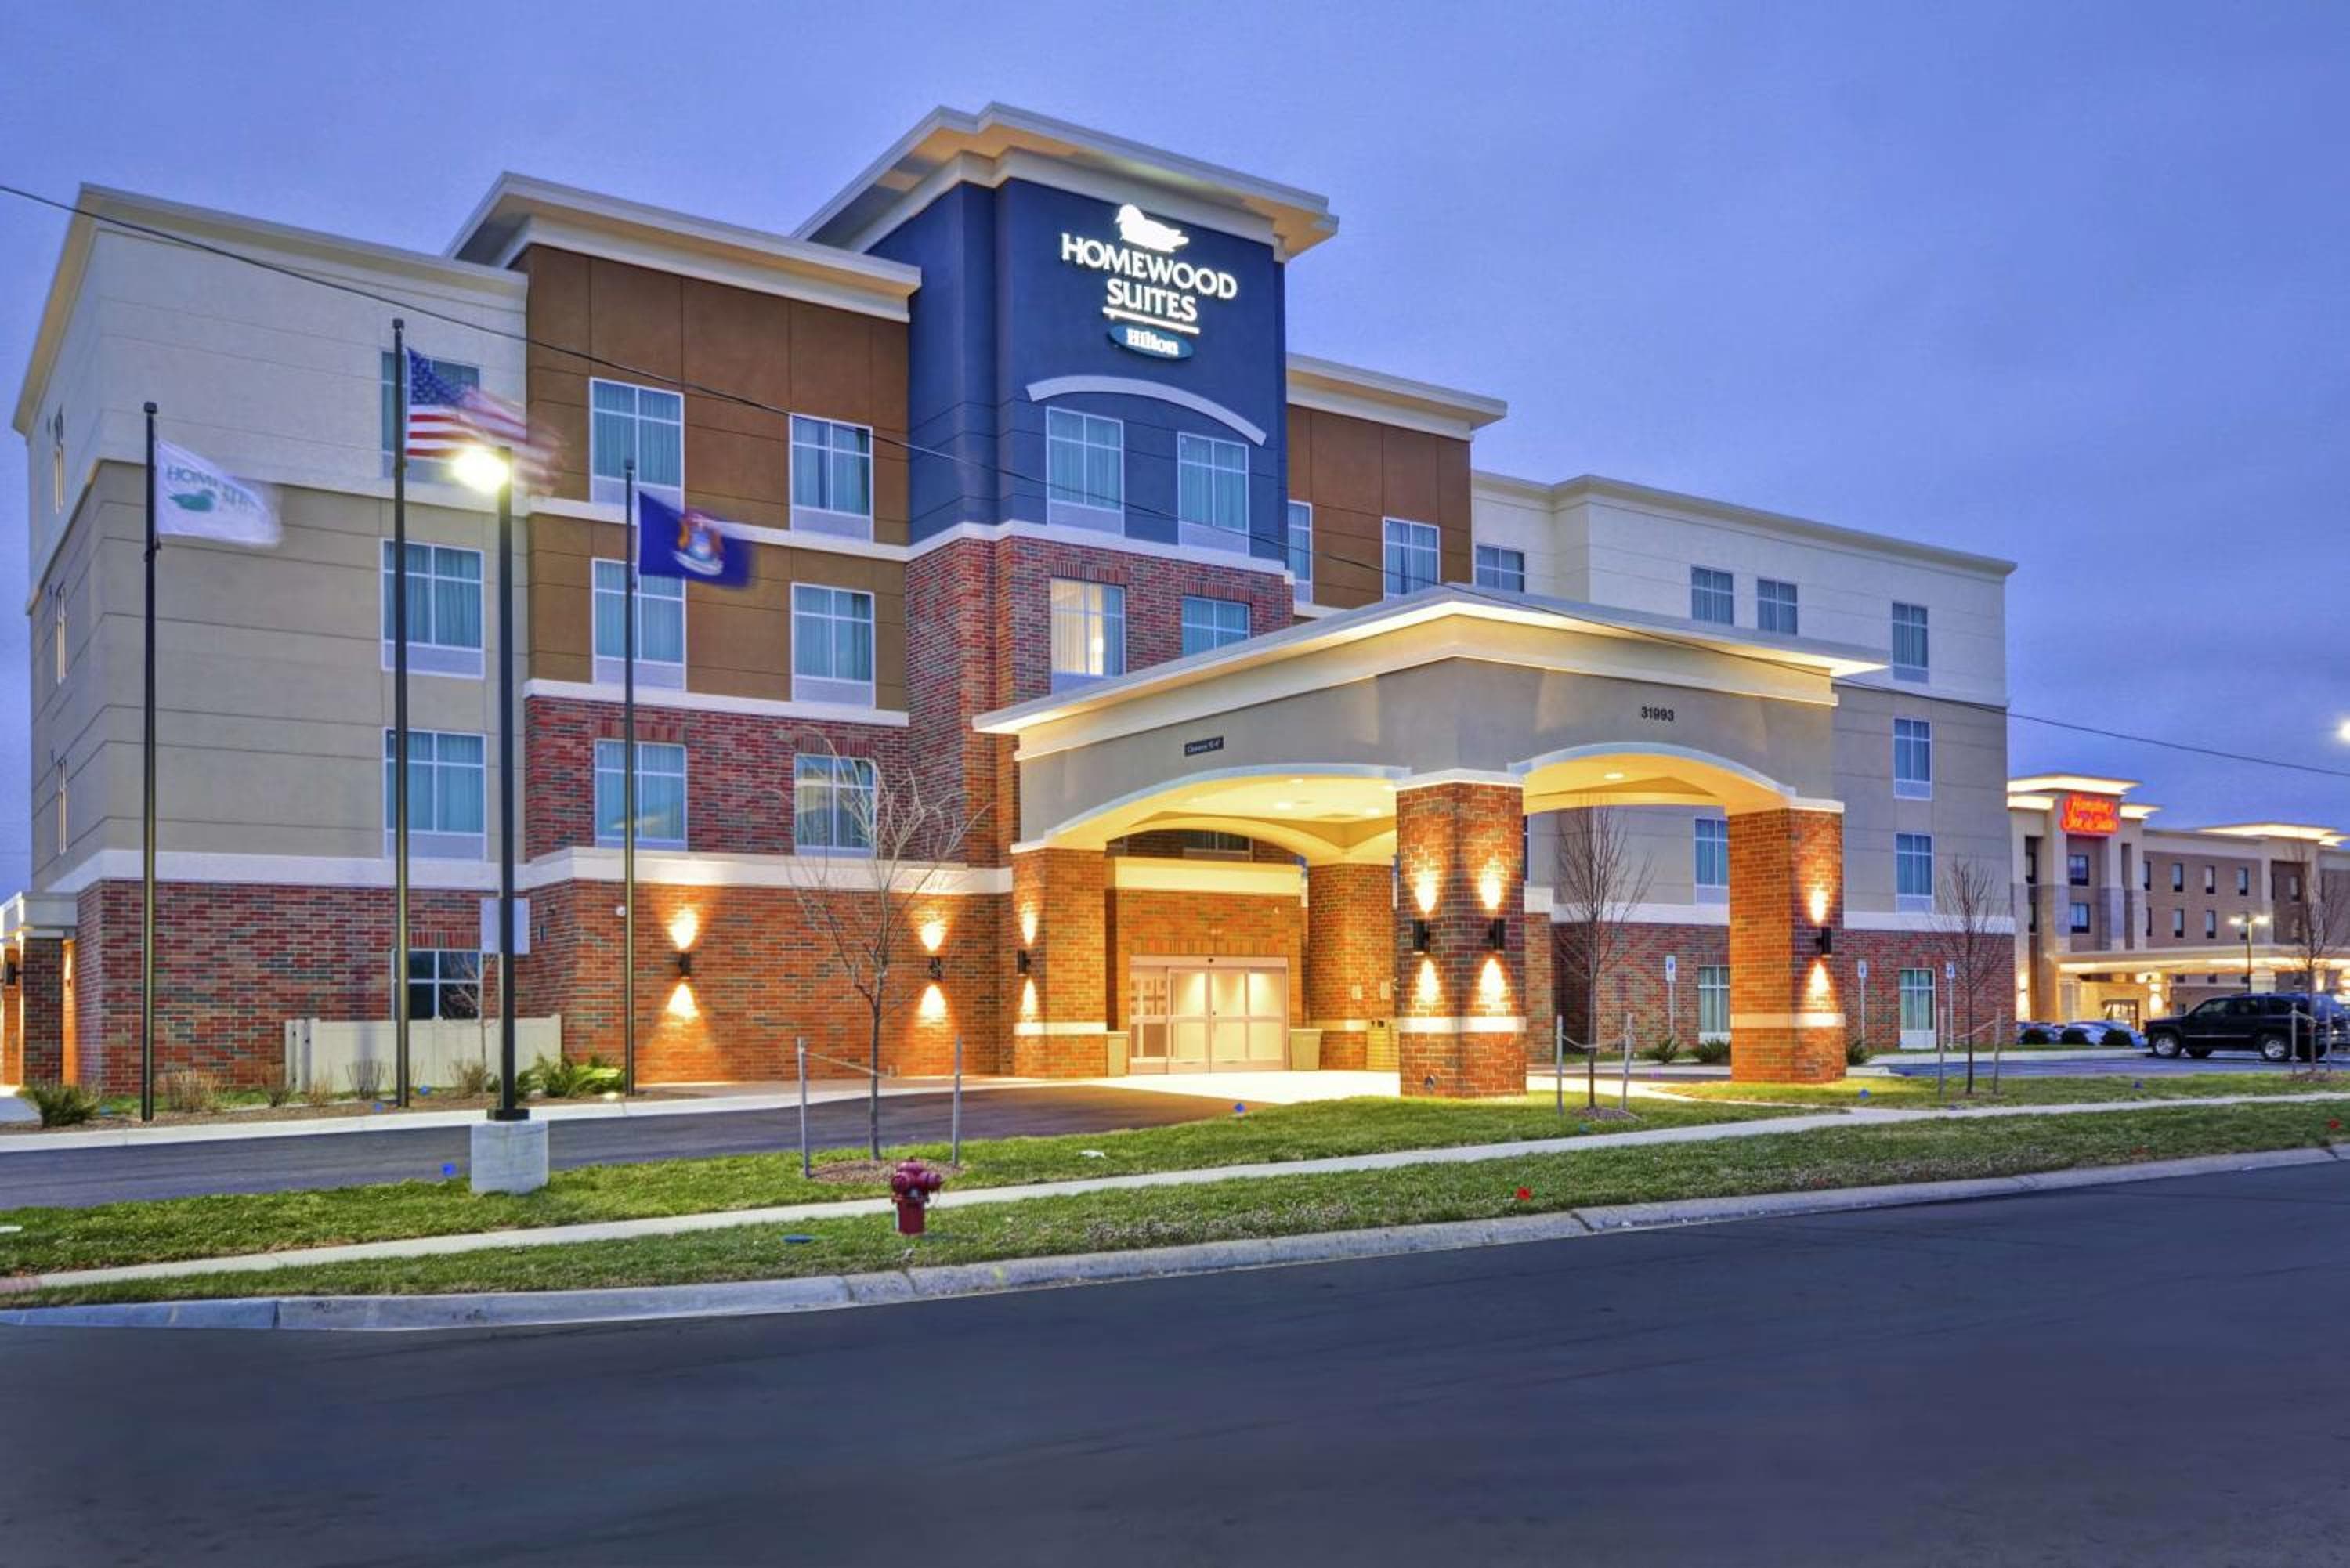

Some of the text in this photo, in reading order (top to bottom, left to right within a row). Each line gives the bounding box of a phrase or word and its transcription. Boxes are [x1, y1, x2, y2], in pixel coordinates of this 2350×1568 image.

[1061, 233, 1238, 299] HOMEWOOD
[1106, 278, 1198, 322] SUITES
[1125, 327, 1179, 356] Hilton
